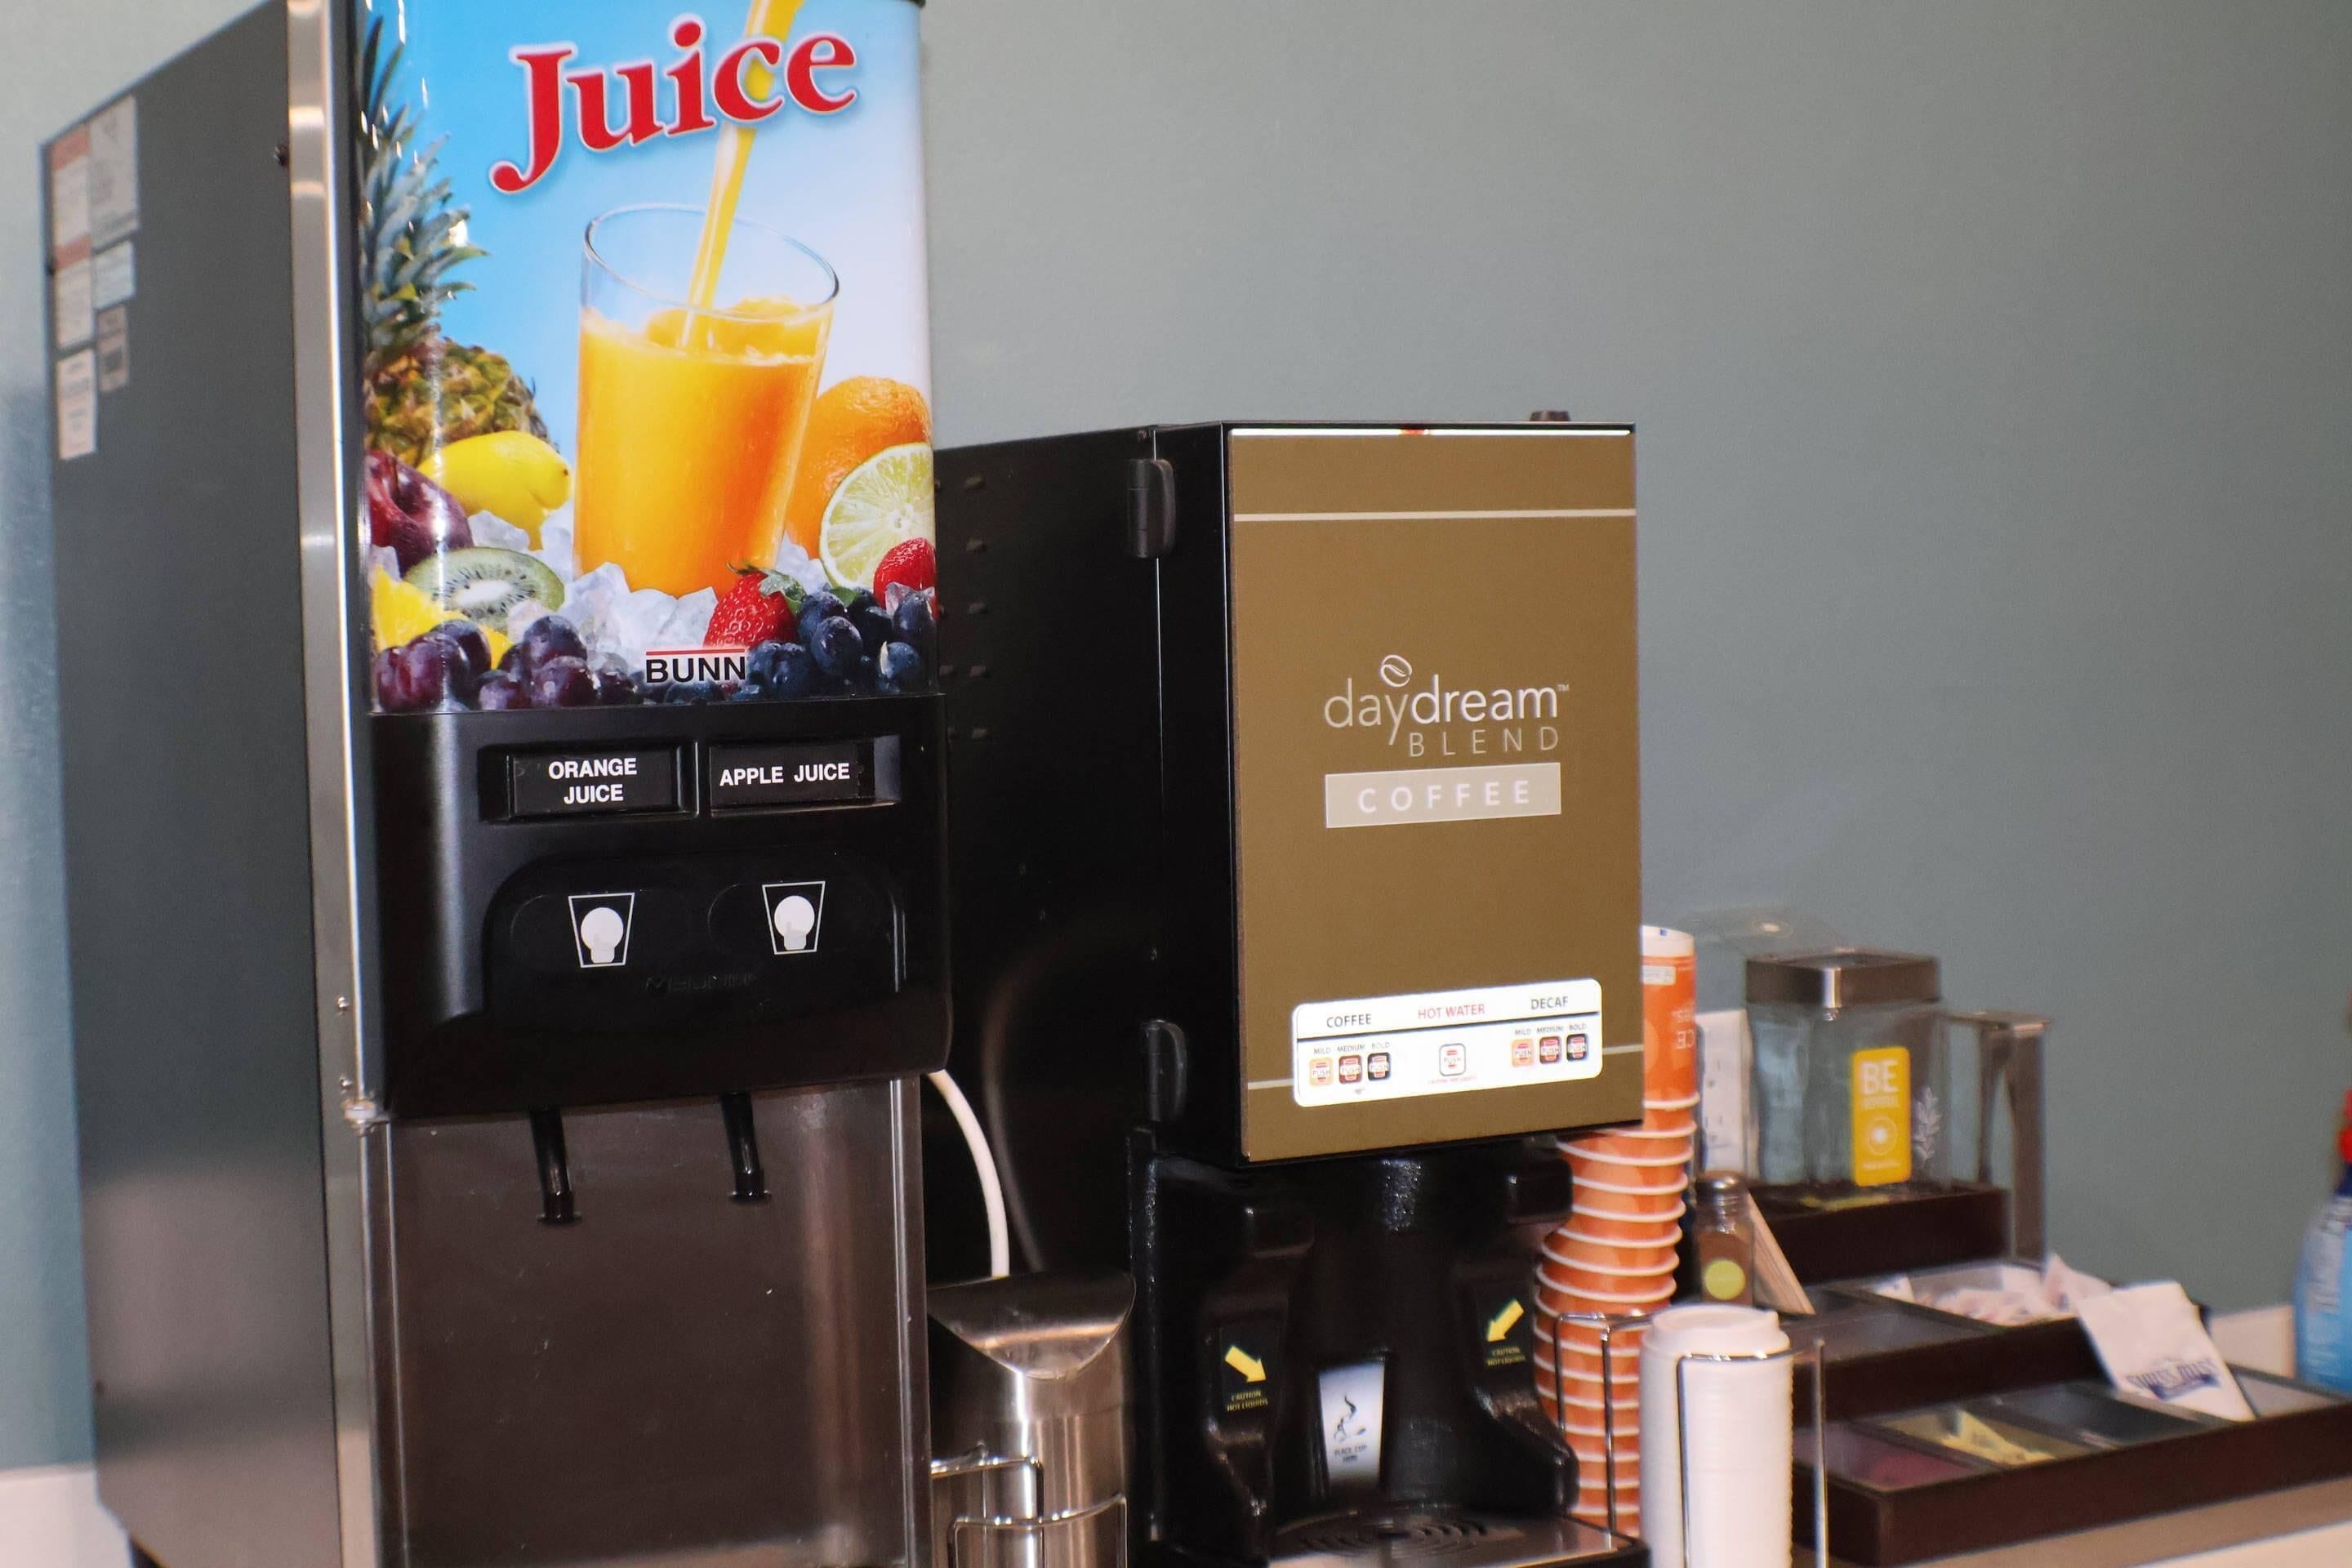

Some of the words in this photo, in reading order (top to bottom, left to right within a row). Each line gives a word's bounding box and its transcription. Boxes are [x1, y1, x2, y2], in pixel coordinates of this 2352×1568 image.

[492, 16, 856, 193] Juice
[645, 656, 746, 684] BUNN
[1409, 726, 1559, 758] BLEND
[548, 757, 637, 781] ORANGE
[719, 766, 784, 786] APPLE
[794, 762, 850, 782] JUICE
[564, 784, 624, 804] JUICE
[1357, 780, 1530, 813] COFFEE
[1530, 996, 1569, 1010] DECAF
[1418, 1007, 1442, 1020] HOT
[1445, 1003, 1486, 1018] WATER
[1325, 1013, 1372, 1028] COFFEE
[1536, 1025, 1565, 1034] MEDIUM
[1568, 1022, 1587, 1031] BOLD
[1337, 1044, 1366, 1053] MEDIUM
[1371, 1041, 1391, 1049] BOLD
[1569, 1045, 1587, 1053] PUSH
[1313, 1047, 1331, 1055] MILD
[1515, 1049, 1533, 1058] PUSH
[1542, 1047, 1560, 1055] PUSH
[1443, 1056, 1462, 1064] PUSH
[1341, 1066, 1361, 1074] PUSH
[1370, 1064, 1389, 1072] PUSH
[1312, 1069, 1331, 1077] PUSH
[1860, 1058, 1900, 1095] BE
